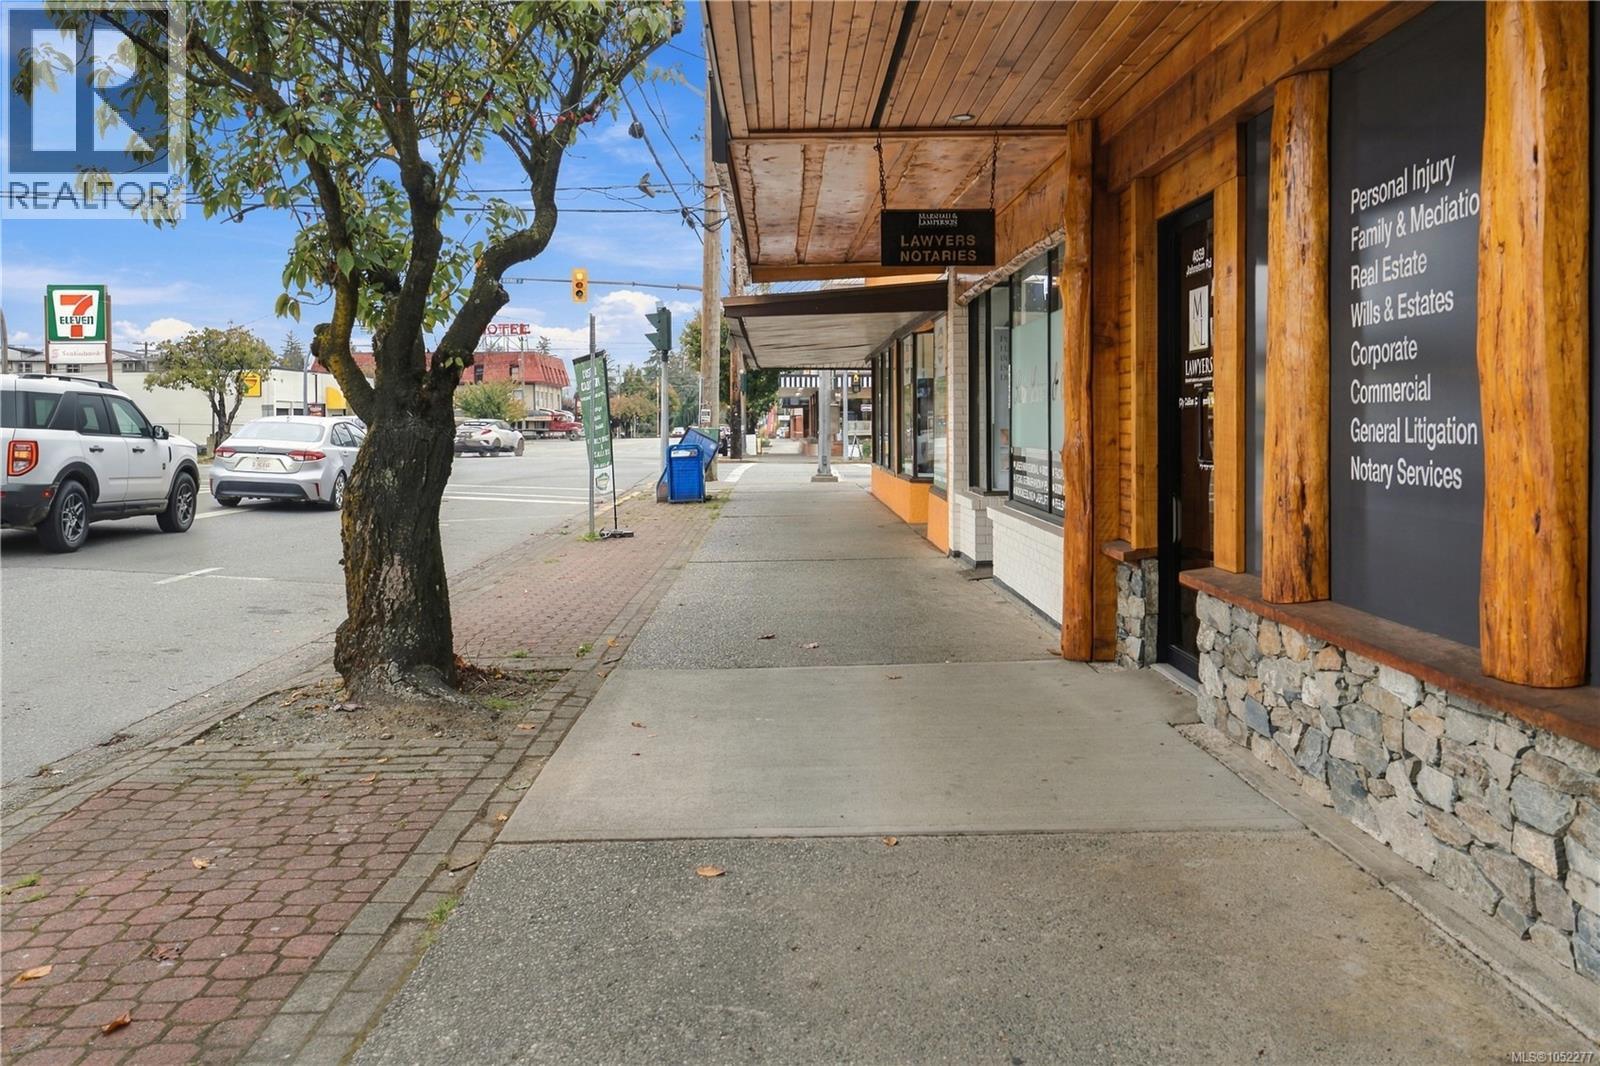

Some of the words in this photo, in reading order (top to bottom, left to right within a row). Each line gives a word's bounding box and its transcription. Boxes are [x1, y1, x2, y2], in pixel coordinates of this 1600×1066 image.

[1350, 167, 1408, 214] Personal
[1412, 155, 1456, 193] Injury
[900, 234, 977, 247] LAWYERS
[1350, 217, 1393, 252] Family
[1396, 210, 1407, 238] &
[900, 250, 977, 262] NOTARIES
[1350, 259, 1378, 290] Real
[1382, 250, 1428, 282] Estate
[60, 295, 93, 337] 7
[1350, 300, 1381, 328] Wills
[1383, 296, 1394, 322] &
[1397, 289, 1454, 320] Estates
[1185, 357, 1213, 376] LAWYERS
[1350, 335, 1418, 370] Corporate
[1350, 373, 1431, 404] Commercial
[1350, 416, 1400, 443] General
[1404, 416, 1478, 451] Litigation
[1350, 456, 1393, 490] Notary
[1397, 457, 1462, 489] Services
